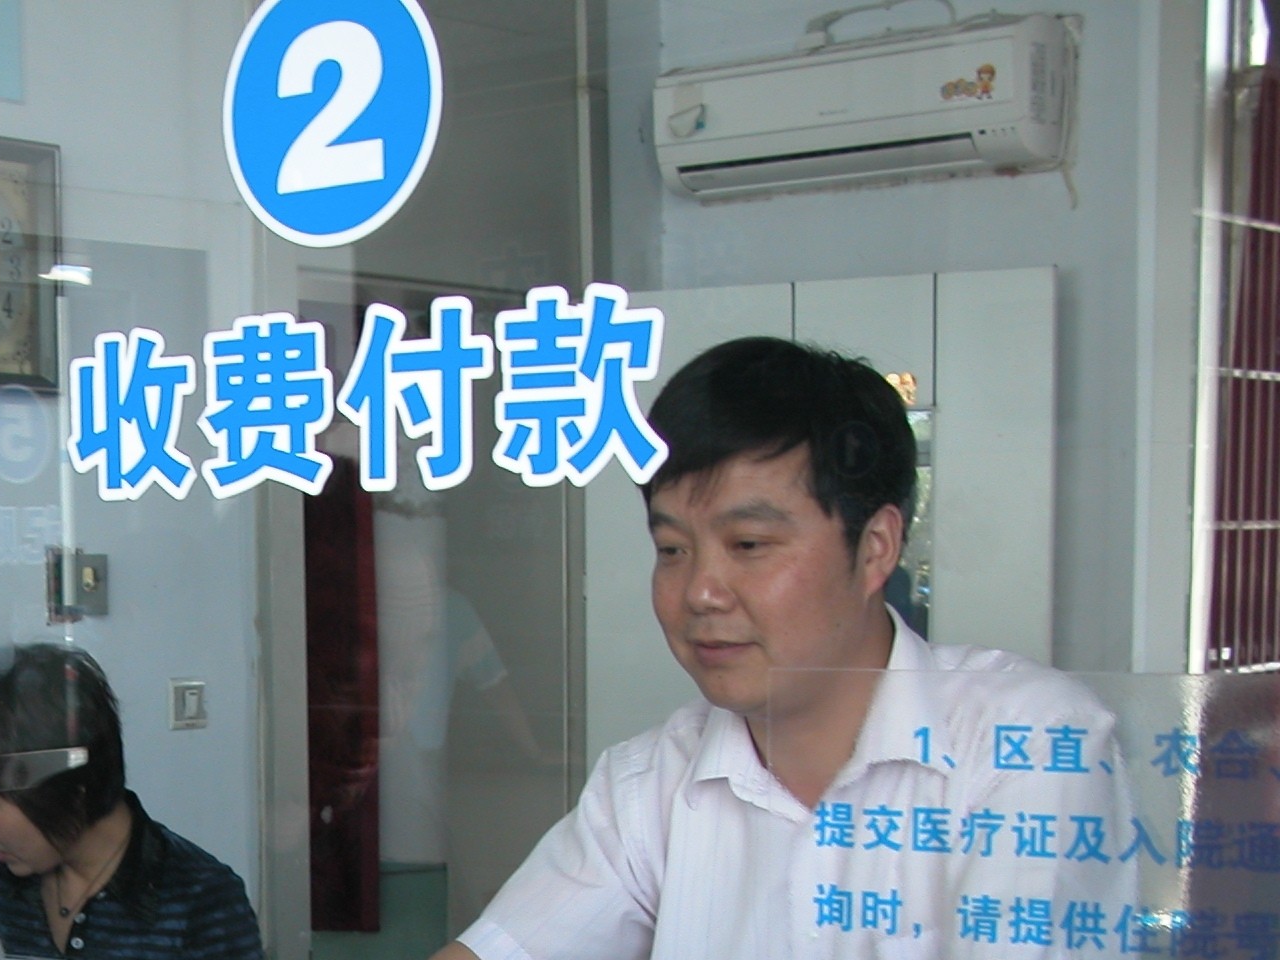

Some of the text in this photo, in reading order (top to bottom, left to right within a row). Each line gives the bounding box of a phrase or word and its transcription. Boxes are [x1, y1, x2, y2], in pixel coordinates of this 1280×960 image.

[276, 20, 385, 195] 2
[0, 218, 14, 246] 2
[2, 291, 14, 319] 4
[72, 288, 667, 496] 收费付款
